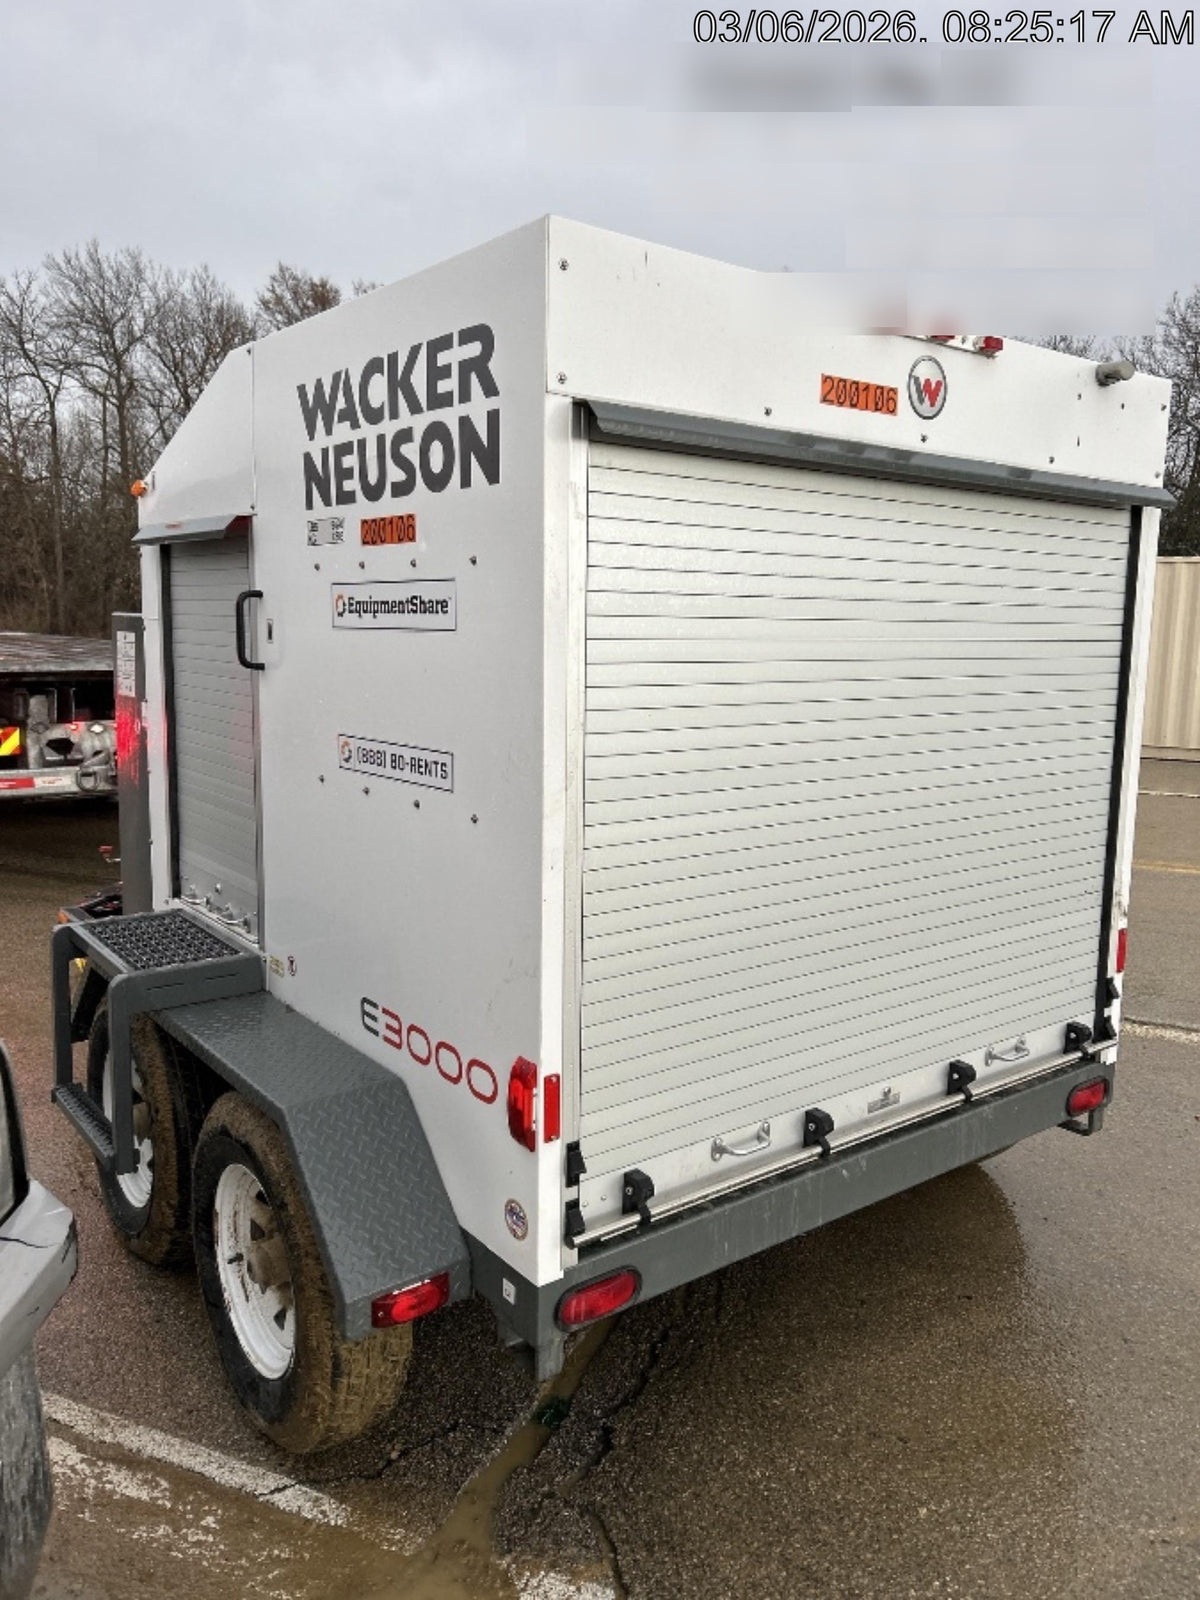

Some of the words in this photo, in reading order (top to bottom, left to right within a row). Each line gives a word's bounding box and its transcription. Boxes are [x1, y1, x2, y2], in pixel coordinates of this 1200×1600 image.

[297, 323, 500, 441] WACKER
[821, 375, 898, 415] 200106
[303, 408, 500, 511] NEUSON
[361, 514, 416, 545] 200106
[347, 595, 449, 619] EquipmentShare
[360, 997, 499, 1105] E3000
